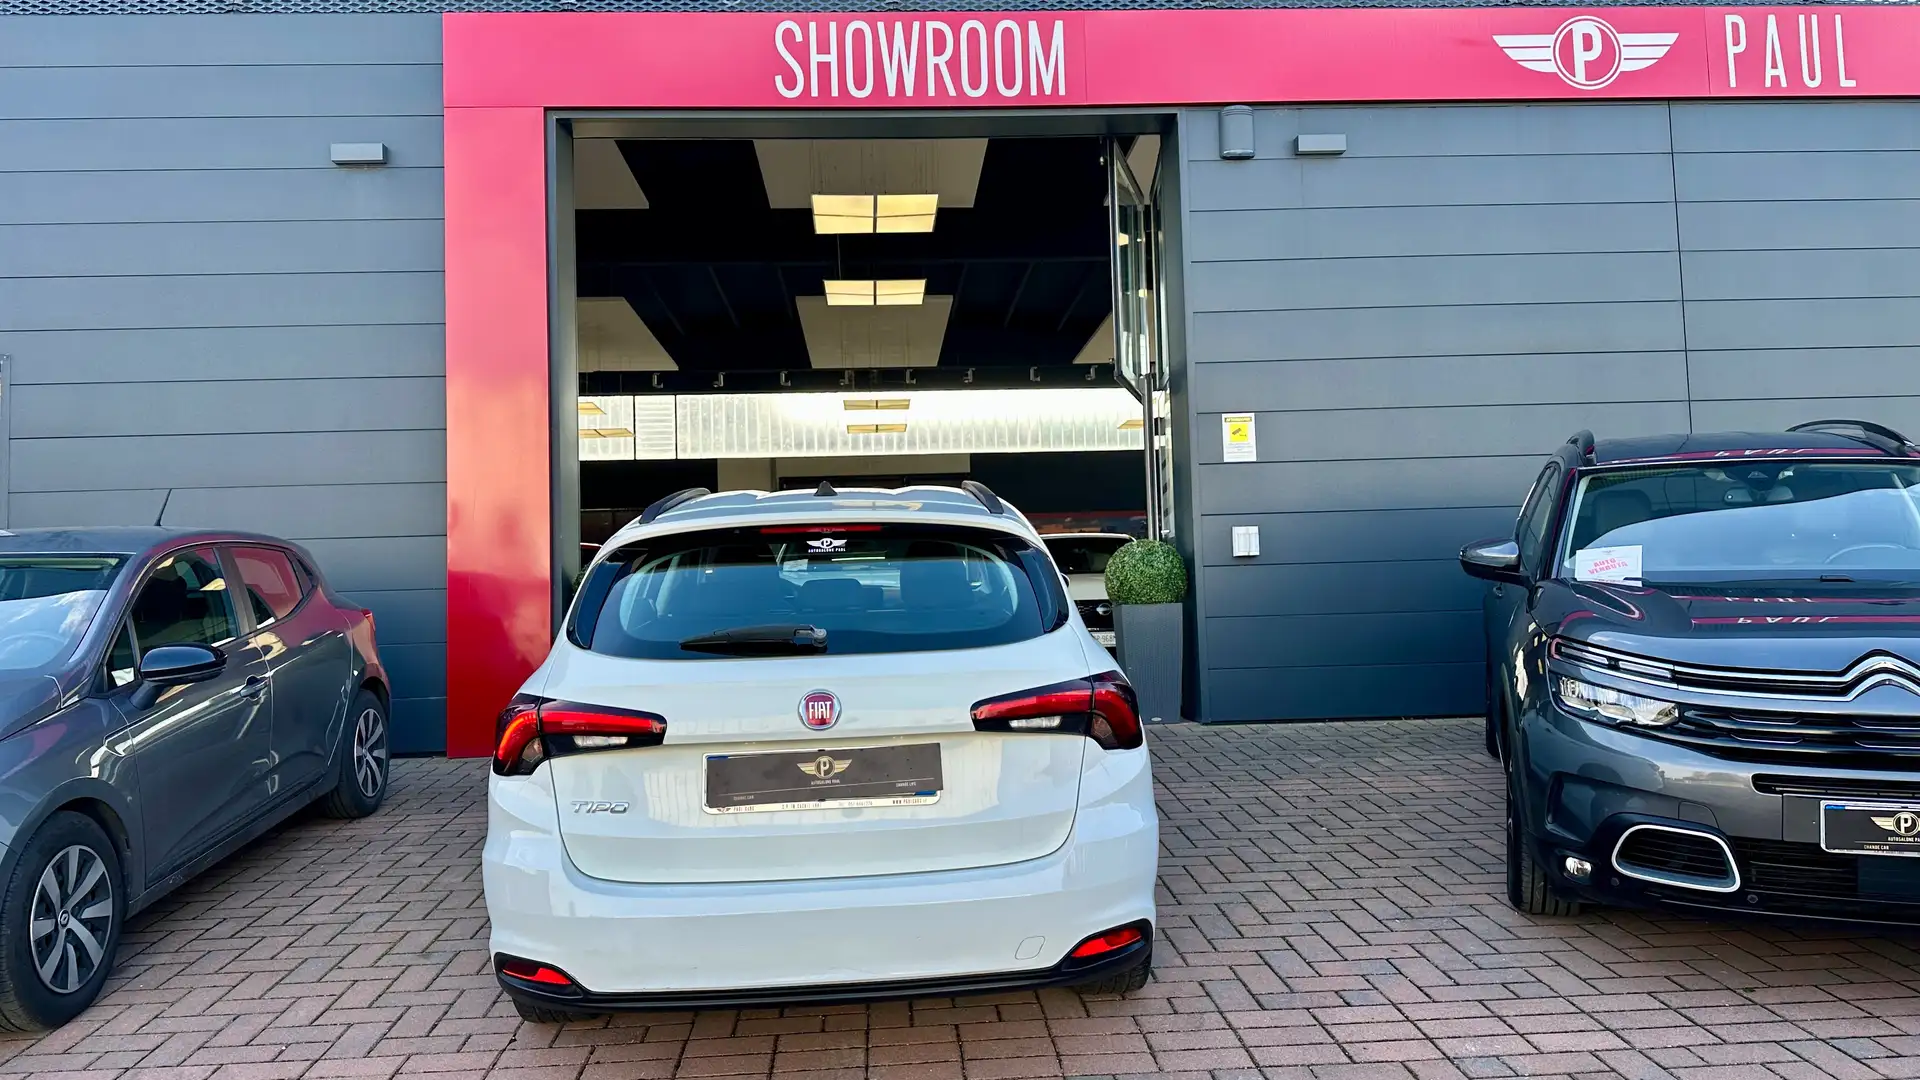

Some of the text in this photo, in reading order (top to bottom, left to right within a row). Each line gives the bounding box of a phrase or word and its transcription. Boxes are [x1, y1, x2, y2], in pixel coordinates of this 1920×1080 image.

[774, 19, 1066, 99] SHOWROOM
[1725, 13, 1857, 88] PAUL
[1587, 561, 1629, 575] VENDUTA
[1593, 557, 1617, 567] AUTO
[808, 700, 832, 720] FIAT
[570, 800, 630, 815] TIPO
